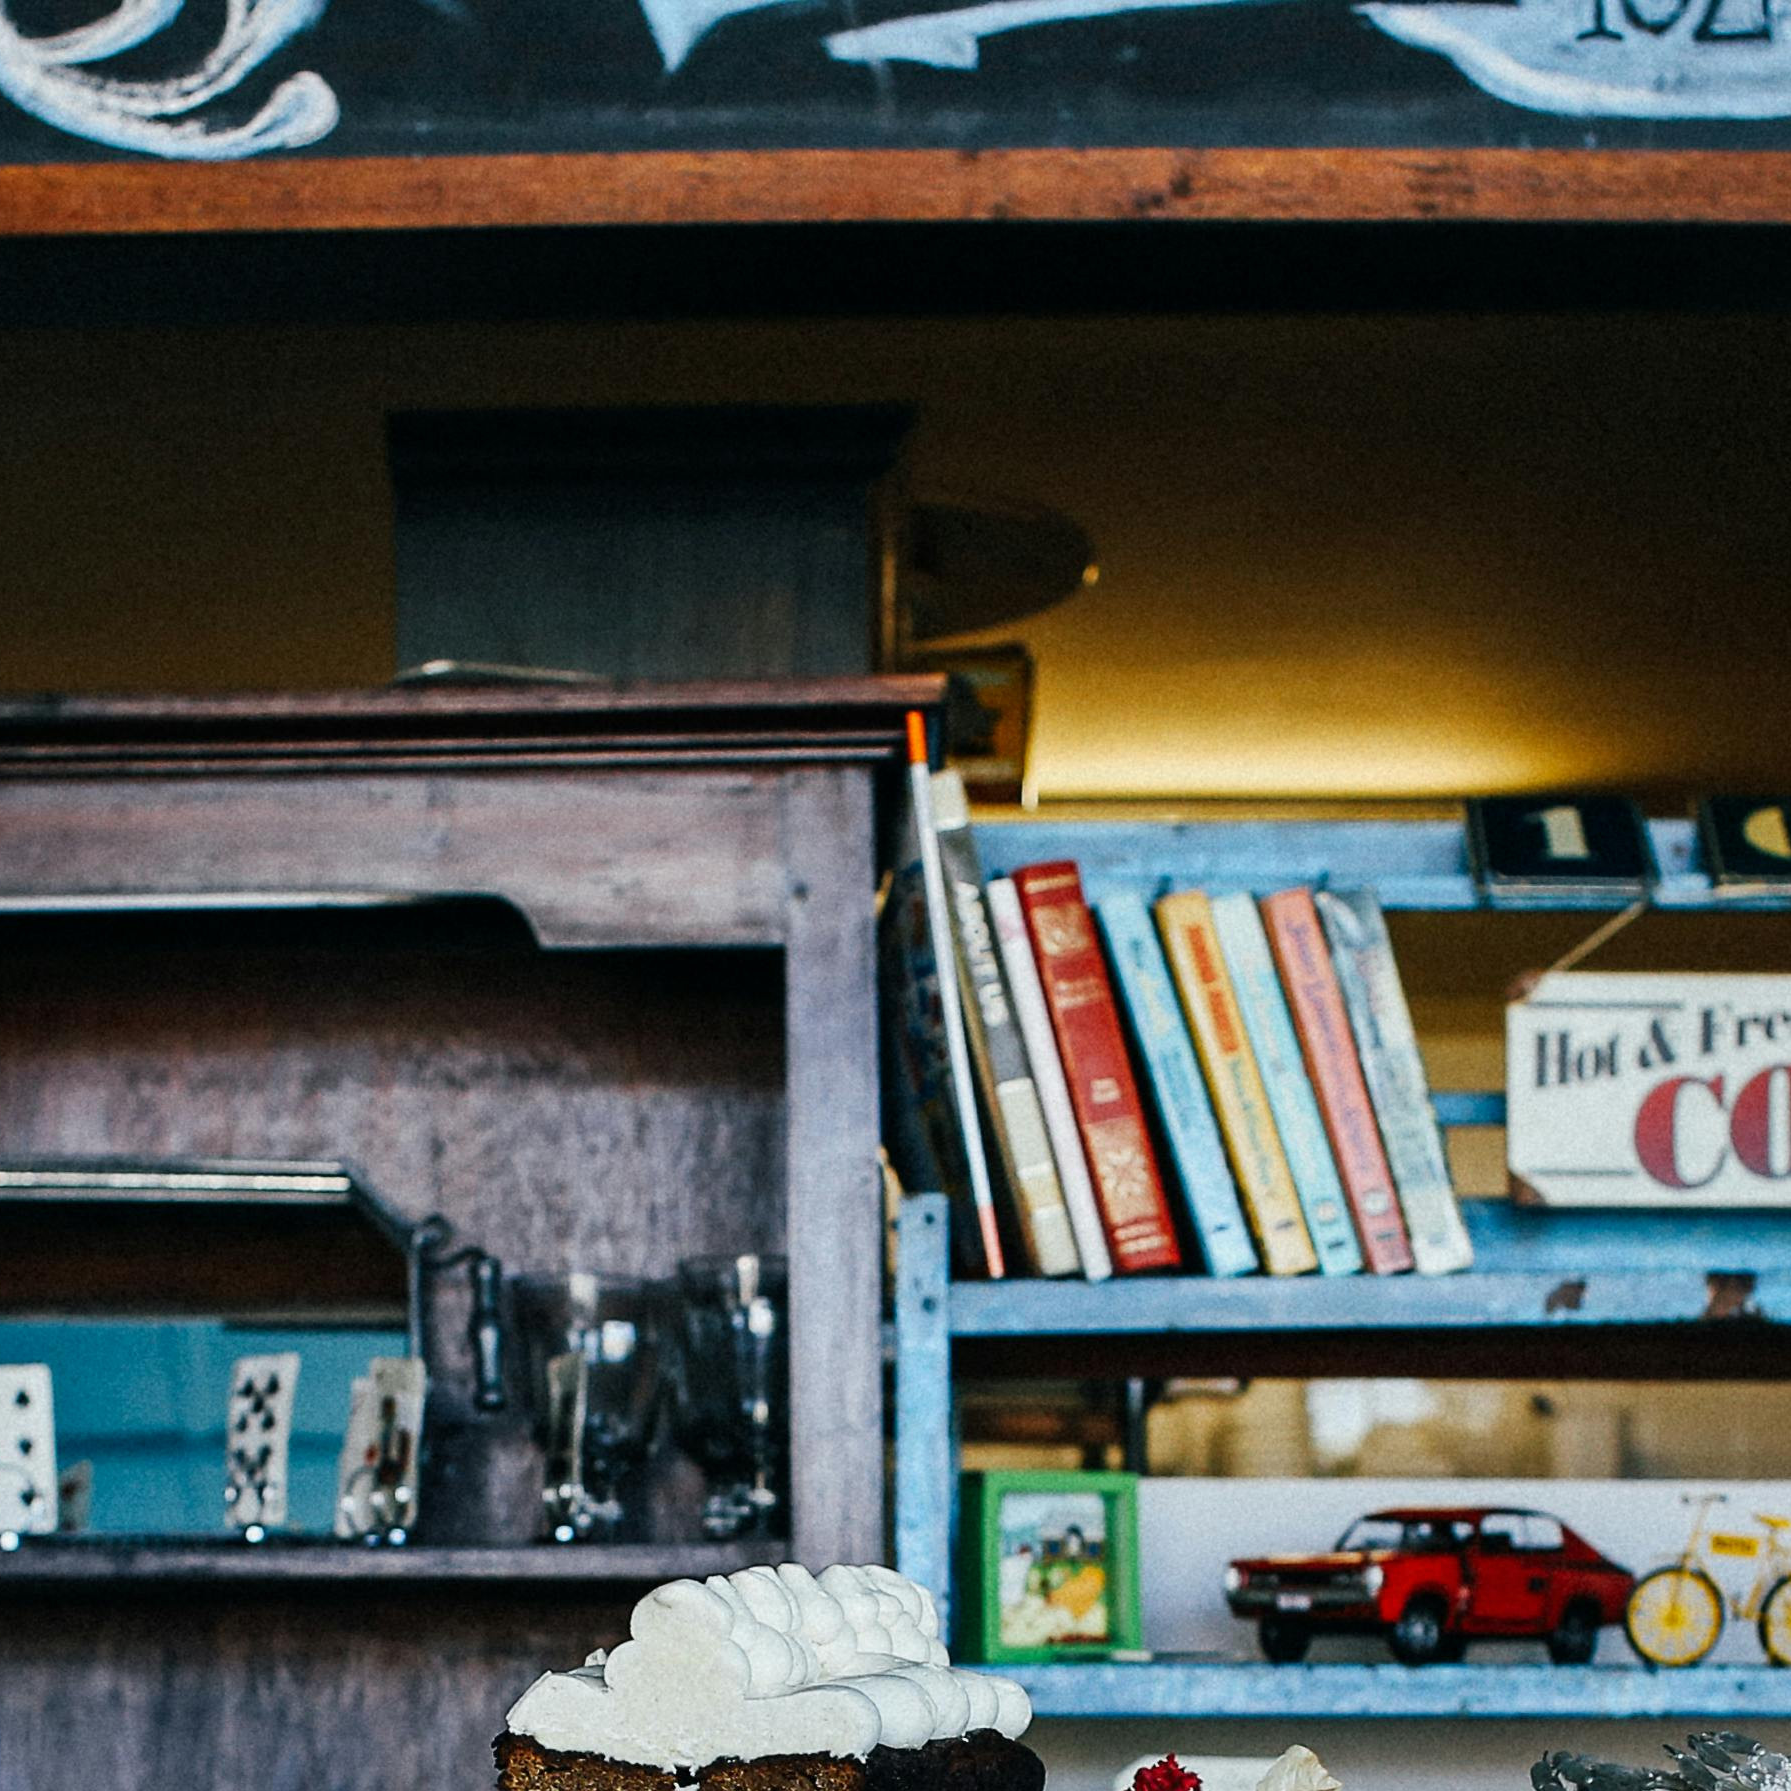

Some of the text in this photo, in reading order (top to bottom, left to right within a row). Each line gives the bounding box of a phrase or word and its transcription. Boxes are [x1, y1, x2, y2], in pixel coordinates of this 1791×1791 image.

[1523, 805, 1589, 860] 1
[1534, 1030, 1620, 1089] Hot
[1637, 1017, 1676, 1069] &
